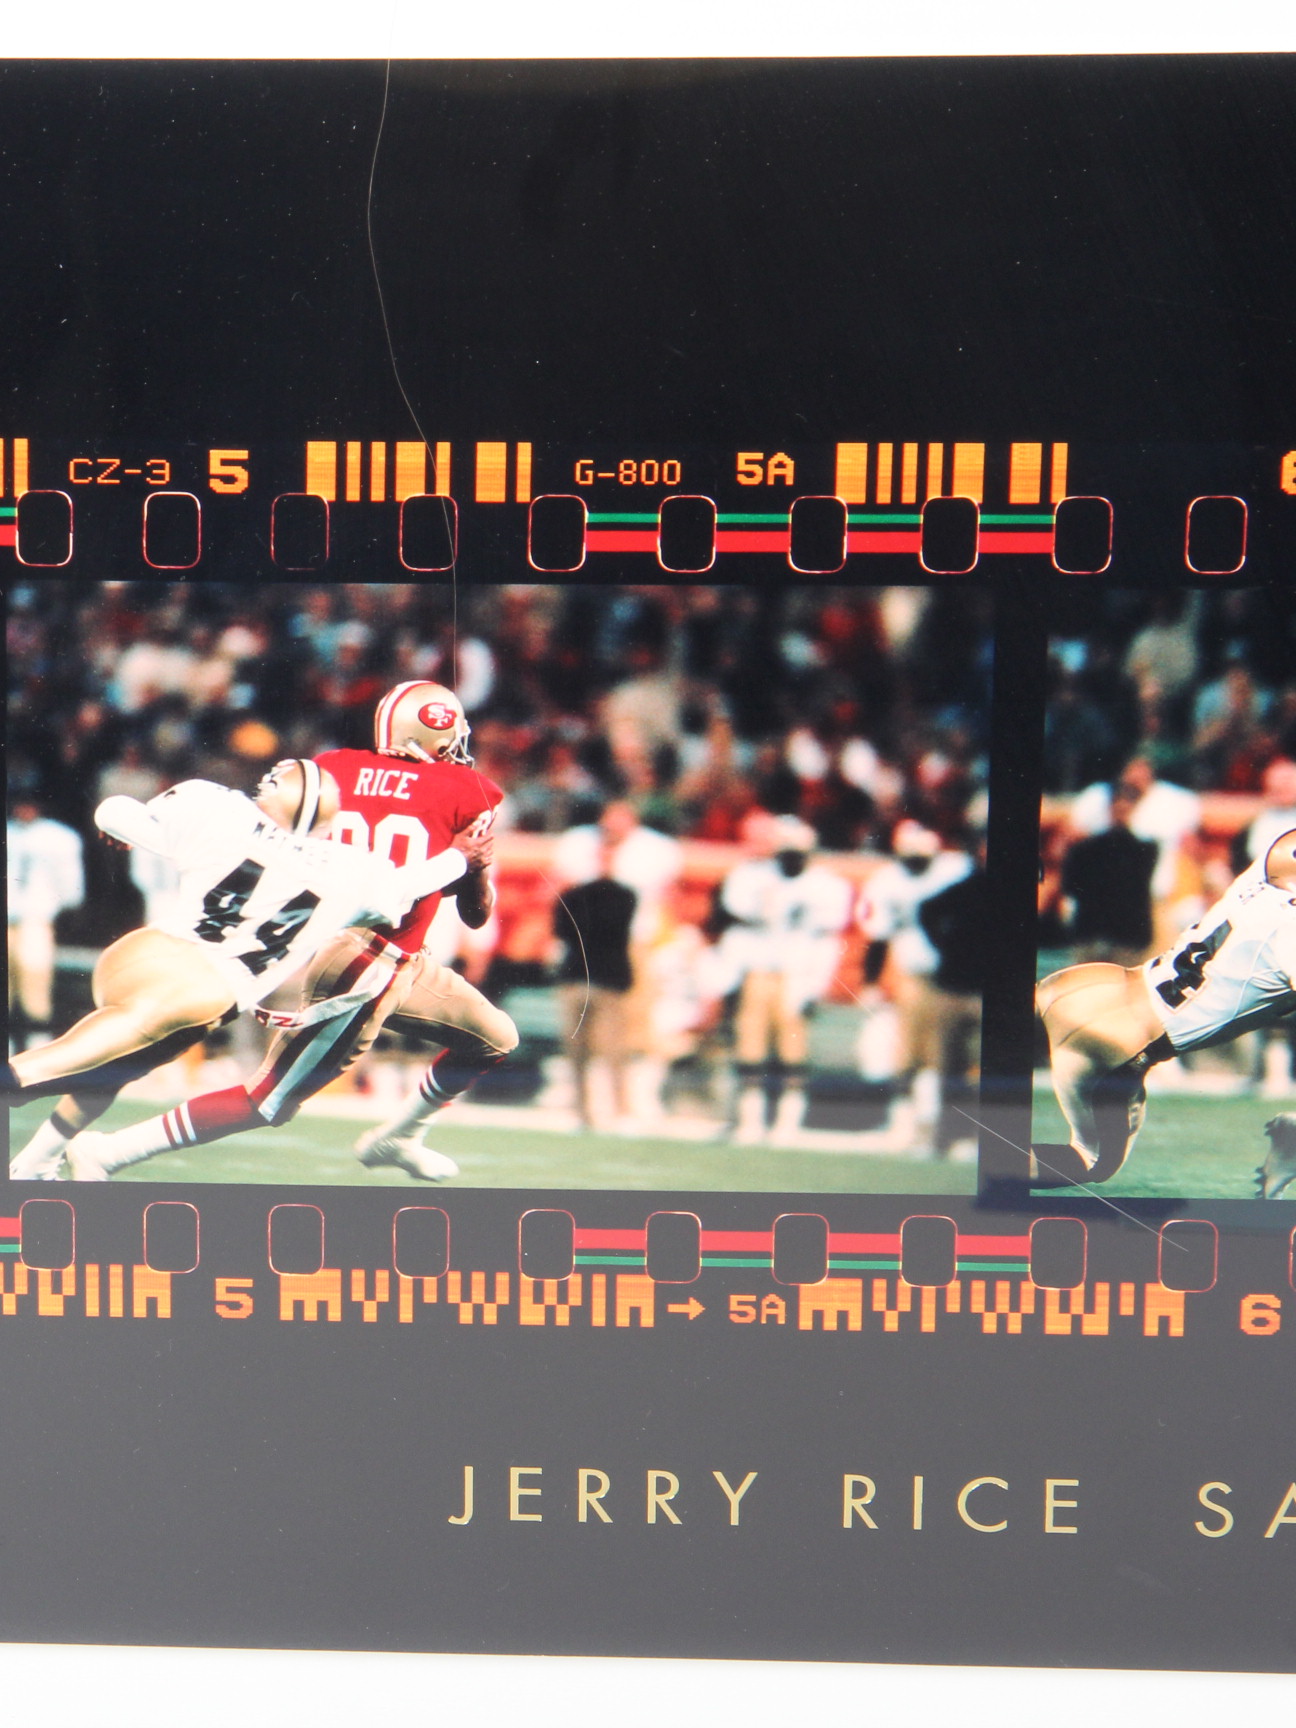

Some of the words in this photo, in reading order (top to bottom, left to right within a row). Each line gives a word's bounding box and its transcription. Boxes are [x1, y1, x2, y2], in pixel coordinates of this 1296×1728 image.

[68, 458, 171, 485] CZ-3
[208, 448, 250, 494] 5
[574, 459, 682, 487] G-800
[735, 451, 796, 486] 5A
[353, 768, 419, 801] RICE
[193, 858, 322, 977] 44
[214, 1277, 254, 1319] 5
[728, 1293, 787, 1325] 5A
[1239, 1293, 1282, 1336] 6
[448, 1466, 758, 1527] JERRY
[842, 1474, 1080, 1534] RICE
